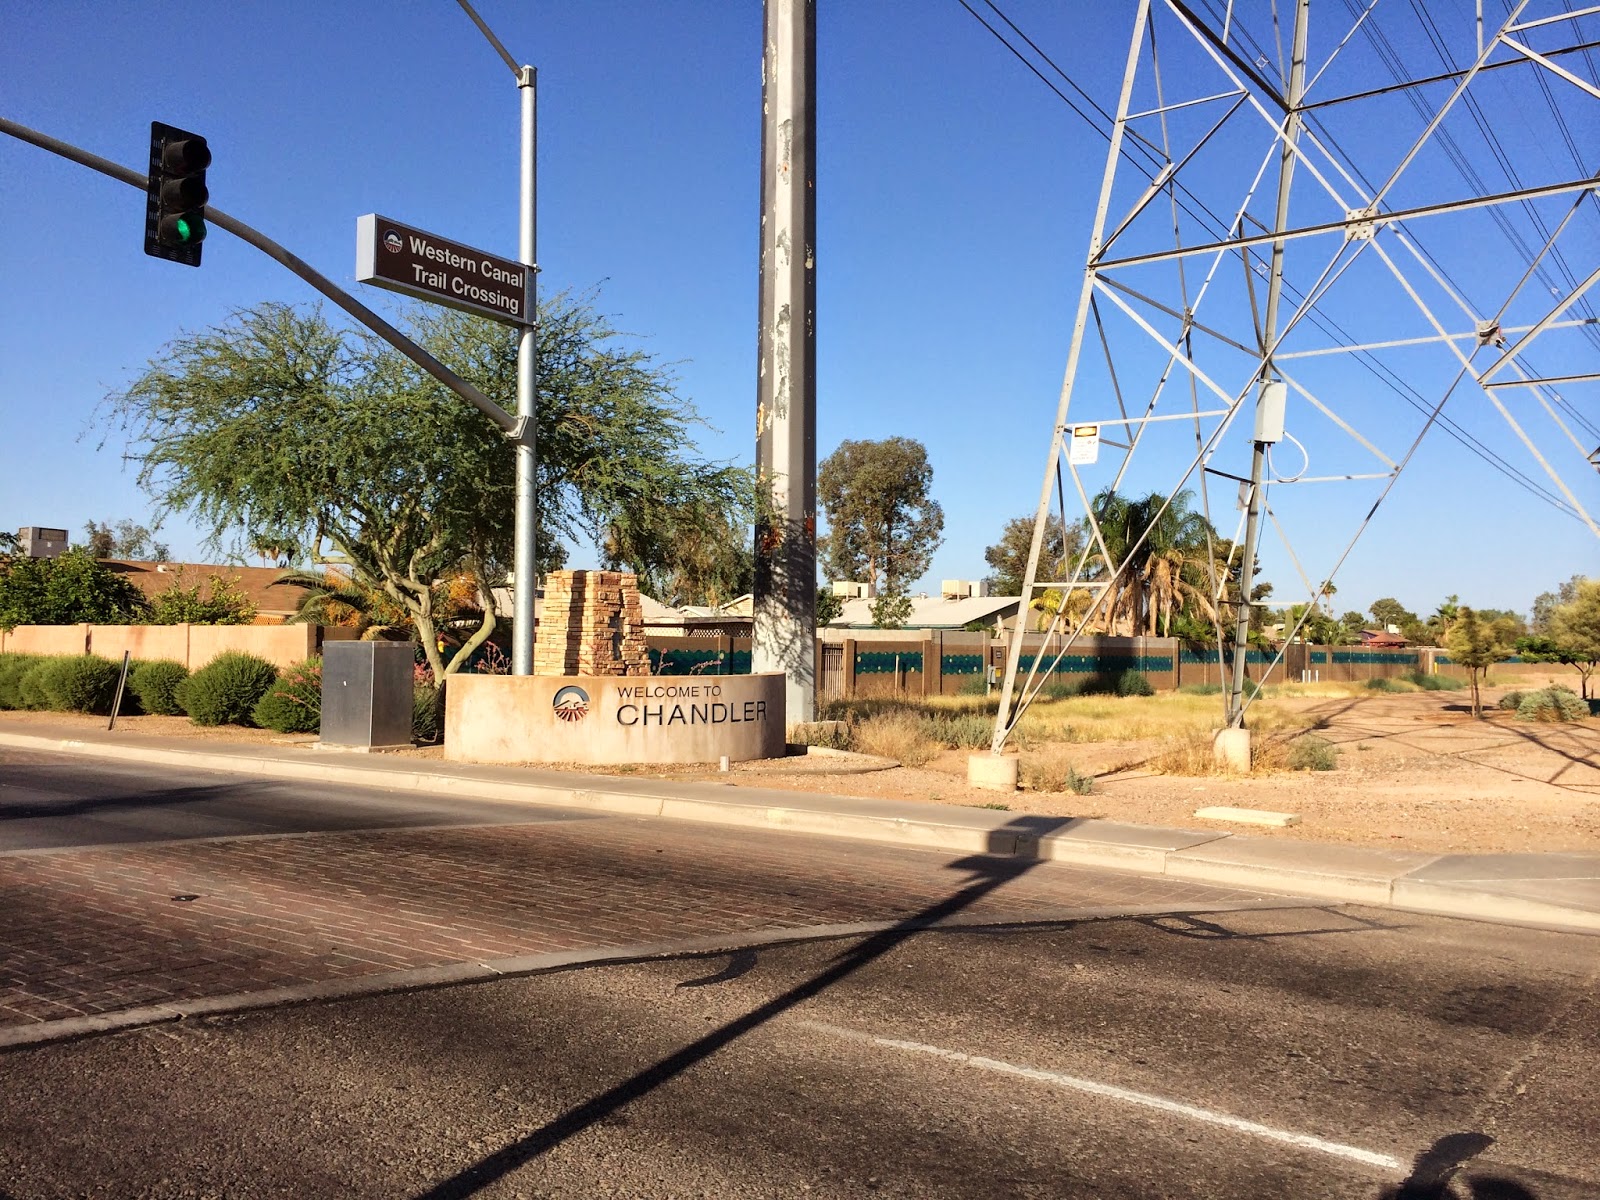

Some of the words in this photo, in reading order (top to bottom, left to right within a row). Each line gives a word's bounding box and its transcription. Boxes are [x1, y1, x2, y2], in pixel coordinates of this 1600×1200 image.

[409, 236, 476, 273] Western
[481, 261, 523, 288] Canal
[412, 264, 447, 290] Trail
[451, 277, 519, 315] Crossing
[617, 686, 699, 698] WELCOME
[703, 685, 722, 697] TO
[616, 701, 767, 725] CHANDLER
